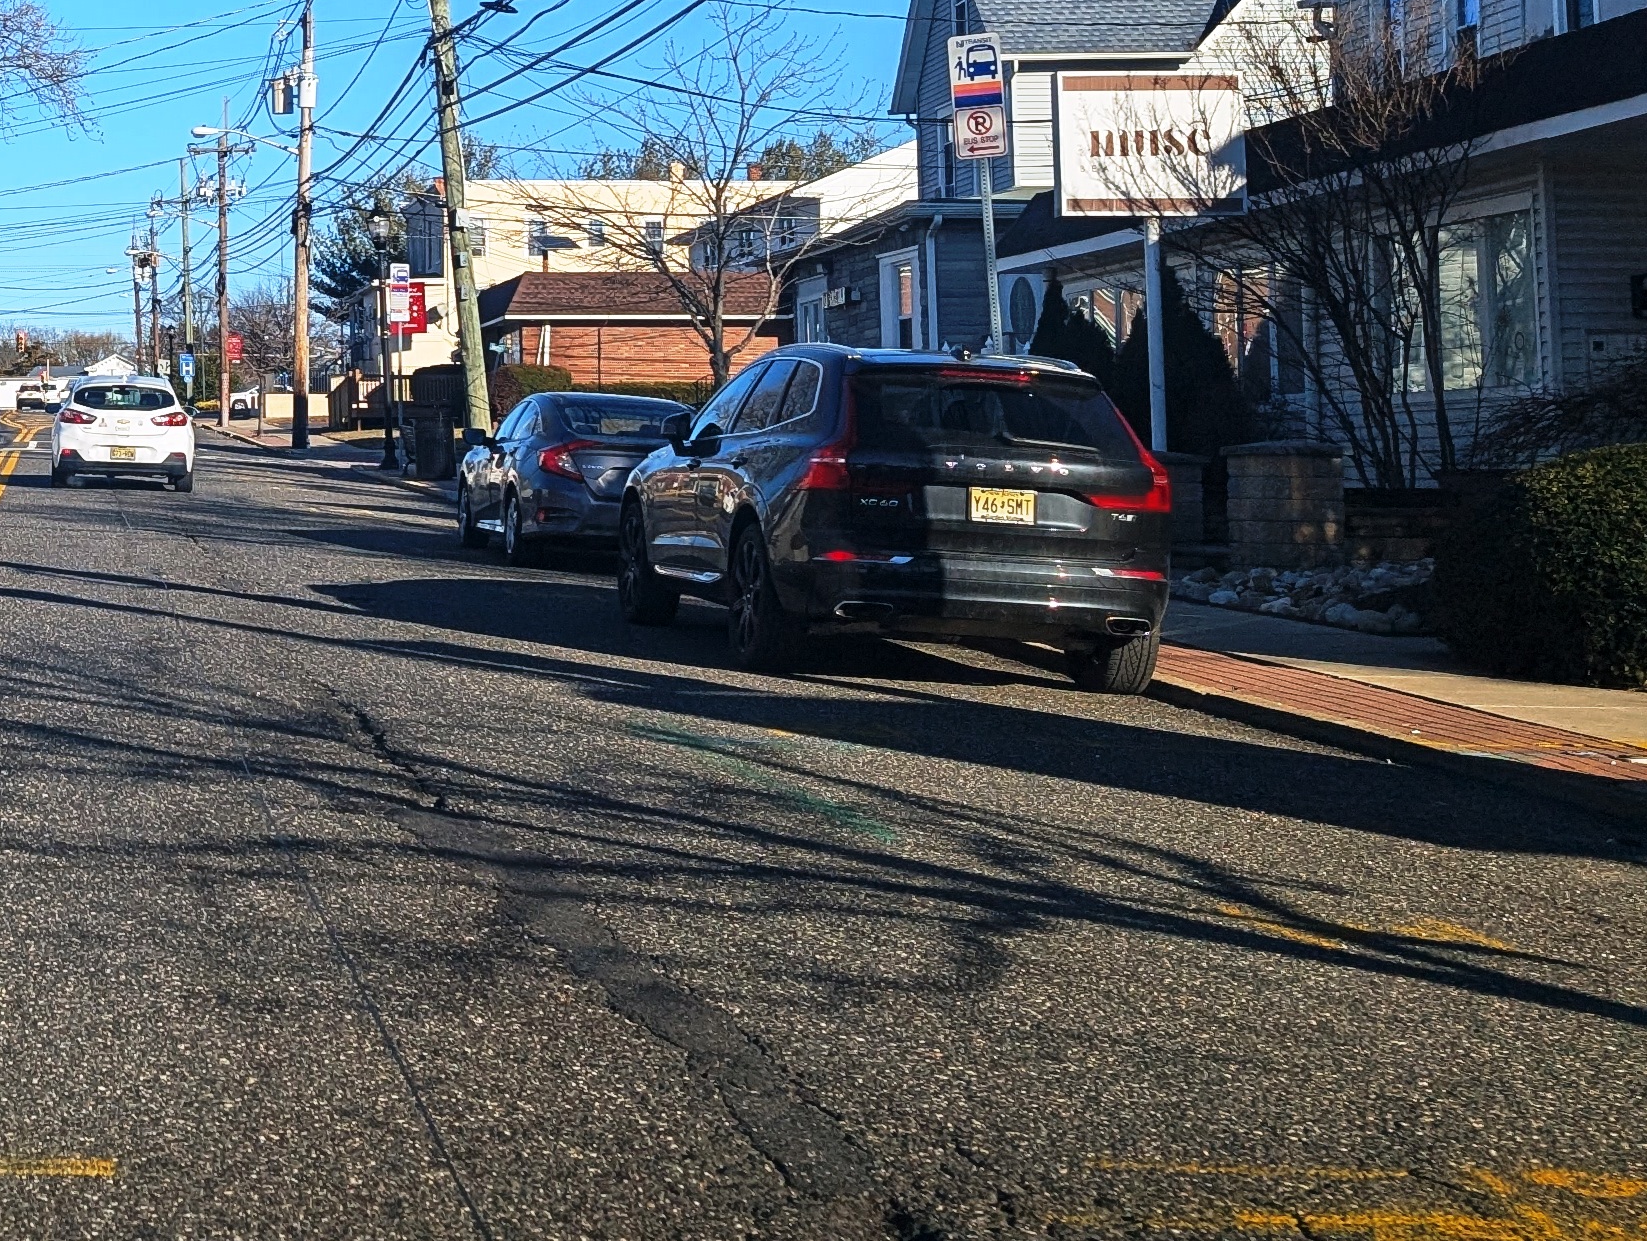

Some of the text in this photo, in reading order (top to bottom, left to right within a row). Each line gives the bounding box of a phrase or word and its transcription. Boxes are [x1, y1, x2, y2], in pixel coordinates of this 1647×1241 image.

[965, 37, 992, 45] TRANSIT
[964, 135, 1000, 146] BUS STOP
[974, 496, 1032, 515] Y46 SMT
